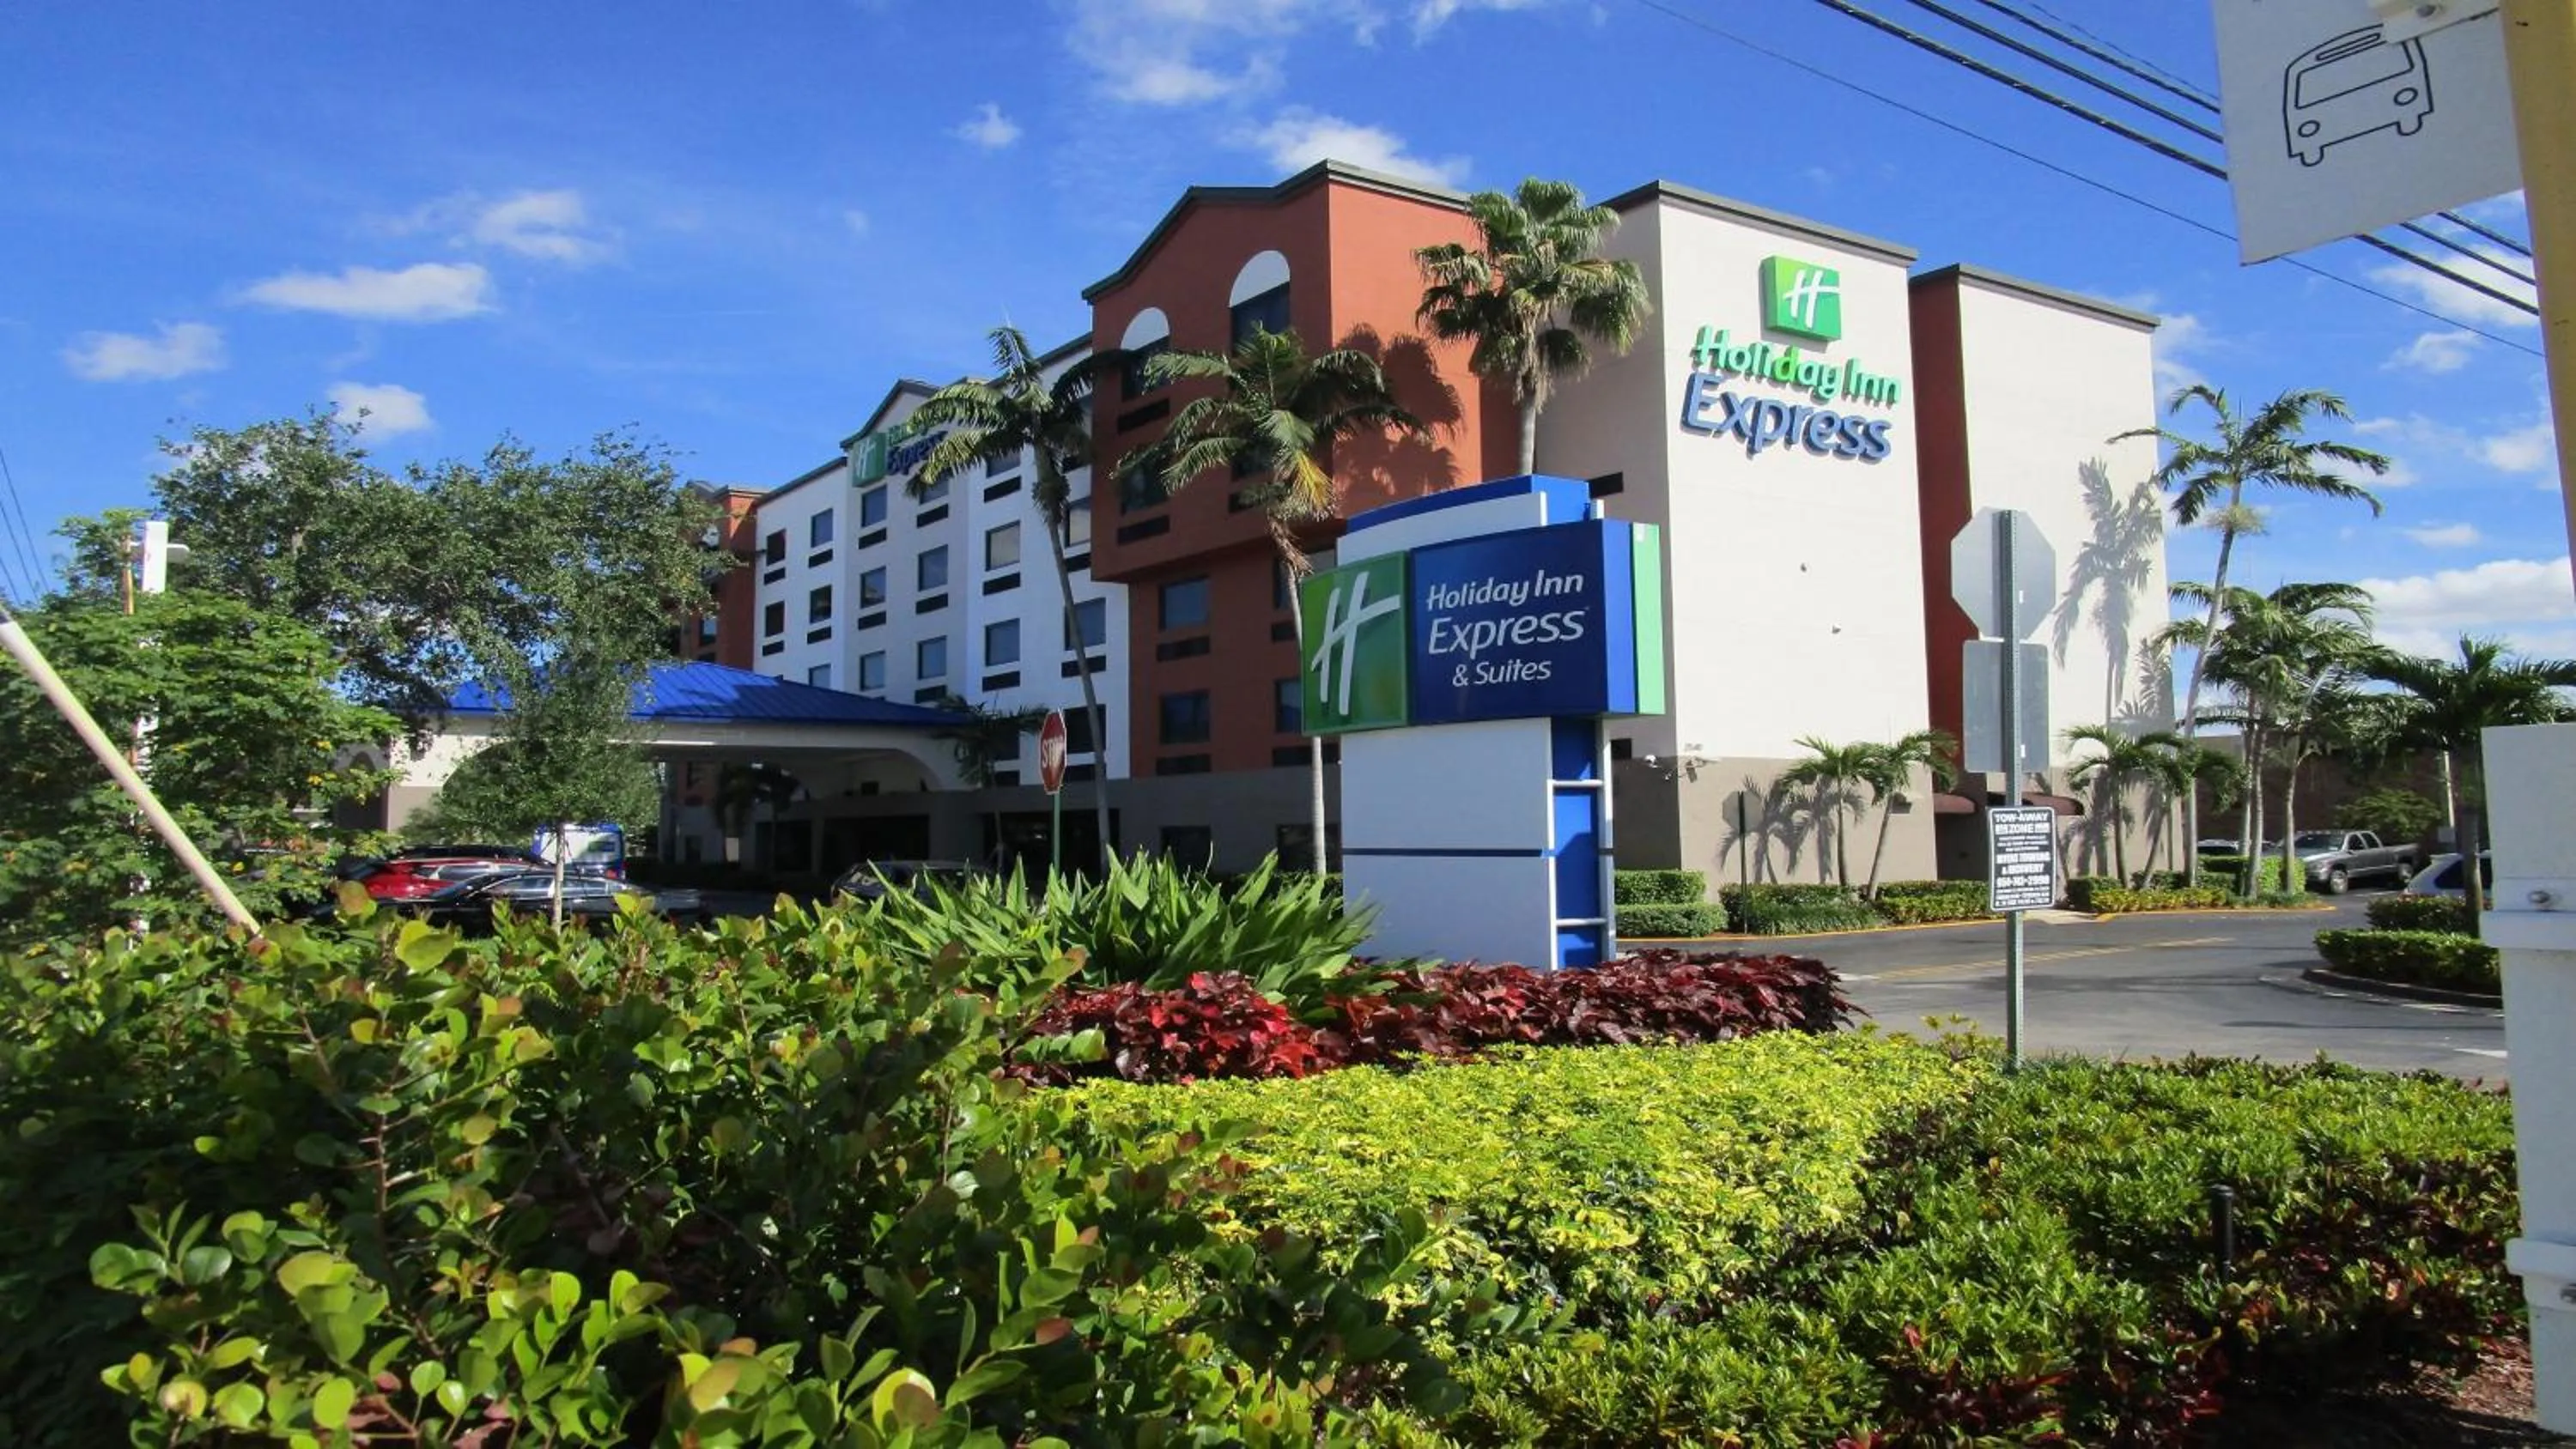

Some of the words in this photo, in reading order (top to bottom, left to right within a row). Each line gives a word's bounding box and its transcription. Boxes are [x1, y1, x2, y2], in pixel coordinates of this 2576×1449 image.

[1691, 324, 1841, 401] Holiday
[1844, 358, 1901, 404] Inn
[1682, 372, 1893, 458] Express
[1427, 577, 1528, 612] Holiday
[1534, 570, 1583, 597] Inn
[1429, 609, 1585, 659] Express
[1452, 665, 1468, 688] &
[1474, 659, 1552, 685] Suites
[1042, 736, 1065, 767] STOP
[1994, 812, 2049, 822] TOW-AWAY
[2008, 823, 2035, 833] ZONE
